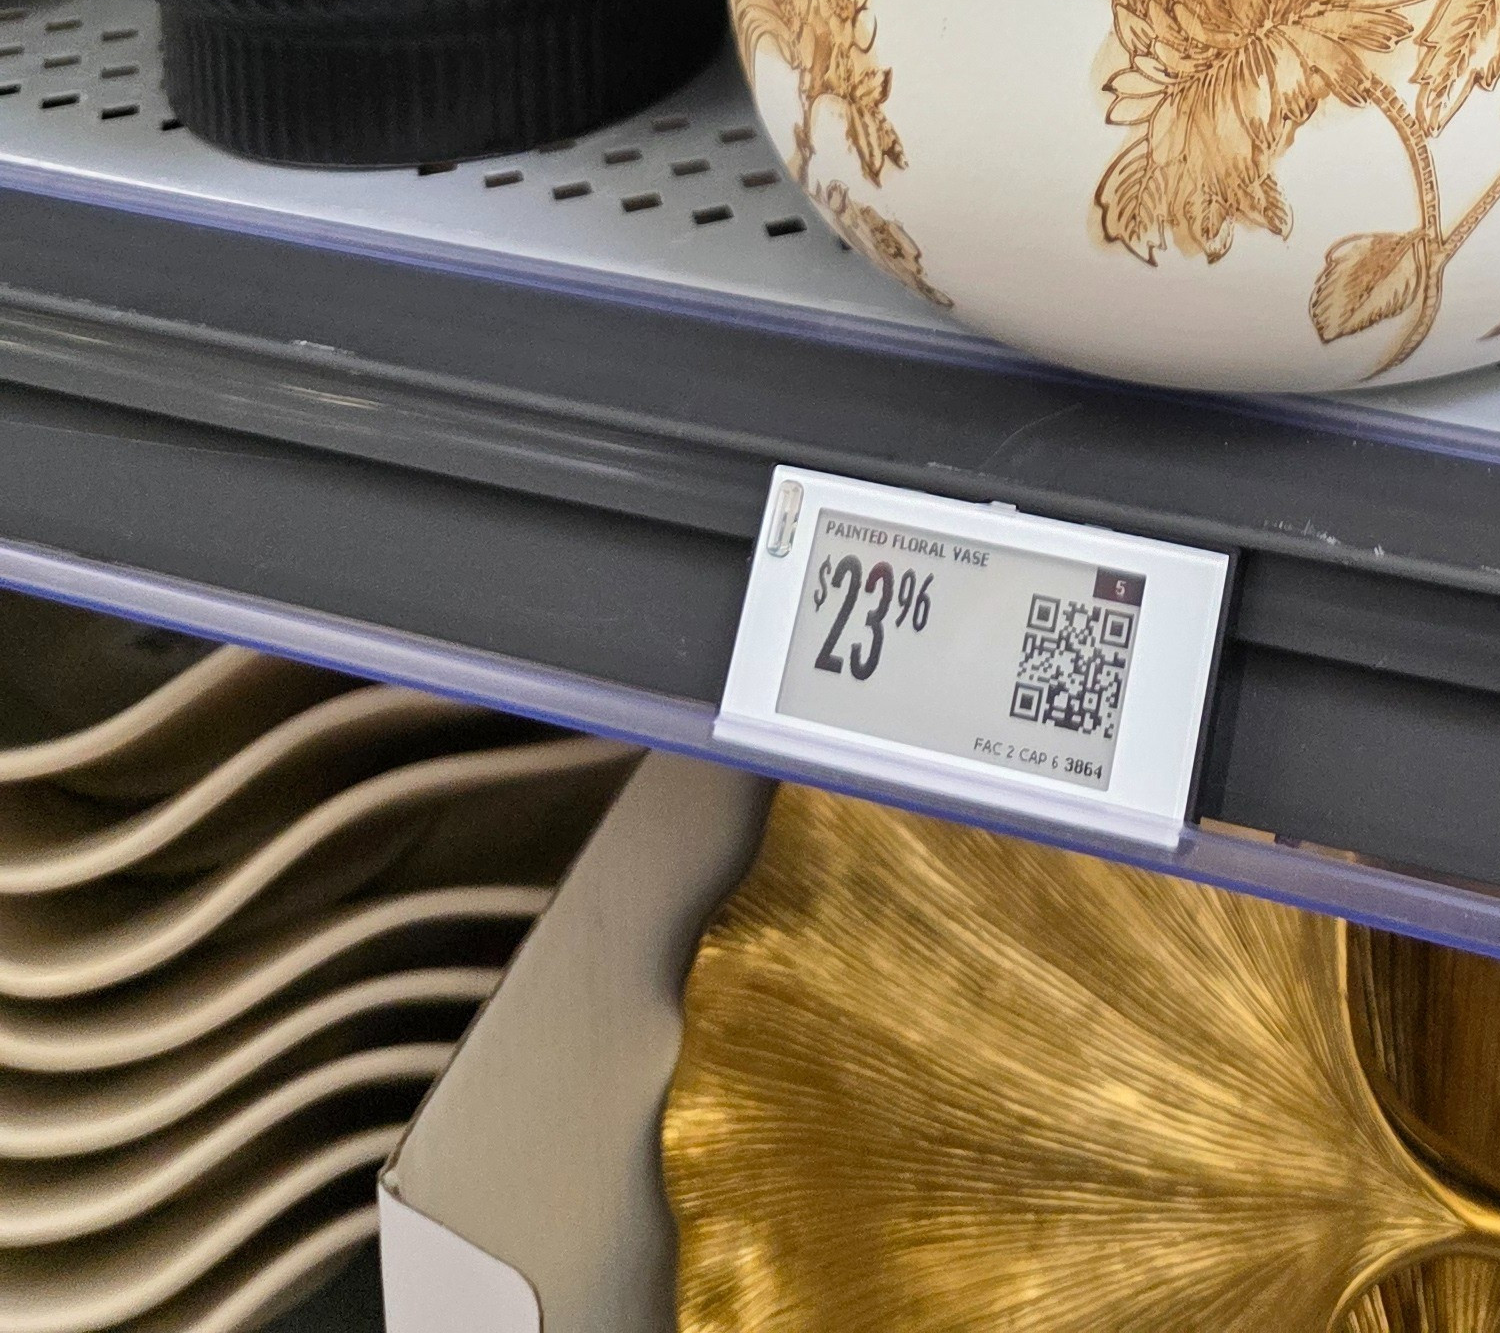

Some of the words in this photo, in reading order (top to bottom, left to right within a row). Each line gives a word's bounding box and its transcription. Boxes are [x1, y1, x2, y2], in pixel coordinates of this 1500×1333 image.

[825, 520, 888, 546] PAINTED
[892, 534, 947, 559] FLORAL
[952, 546, 991, 567] VASE
[1115, 579, 1127, 597] 5
[973, 737, 1003, 757] FAC
[1006, 744, 1015, 759] 2
[1018, 746, 1048, 765] CAP
[1051, 755, 1060, 769] 6
[1063, 756, 1104, 779] 3864
